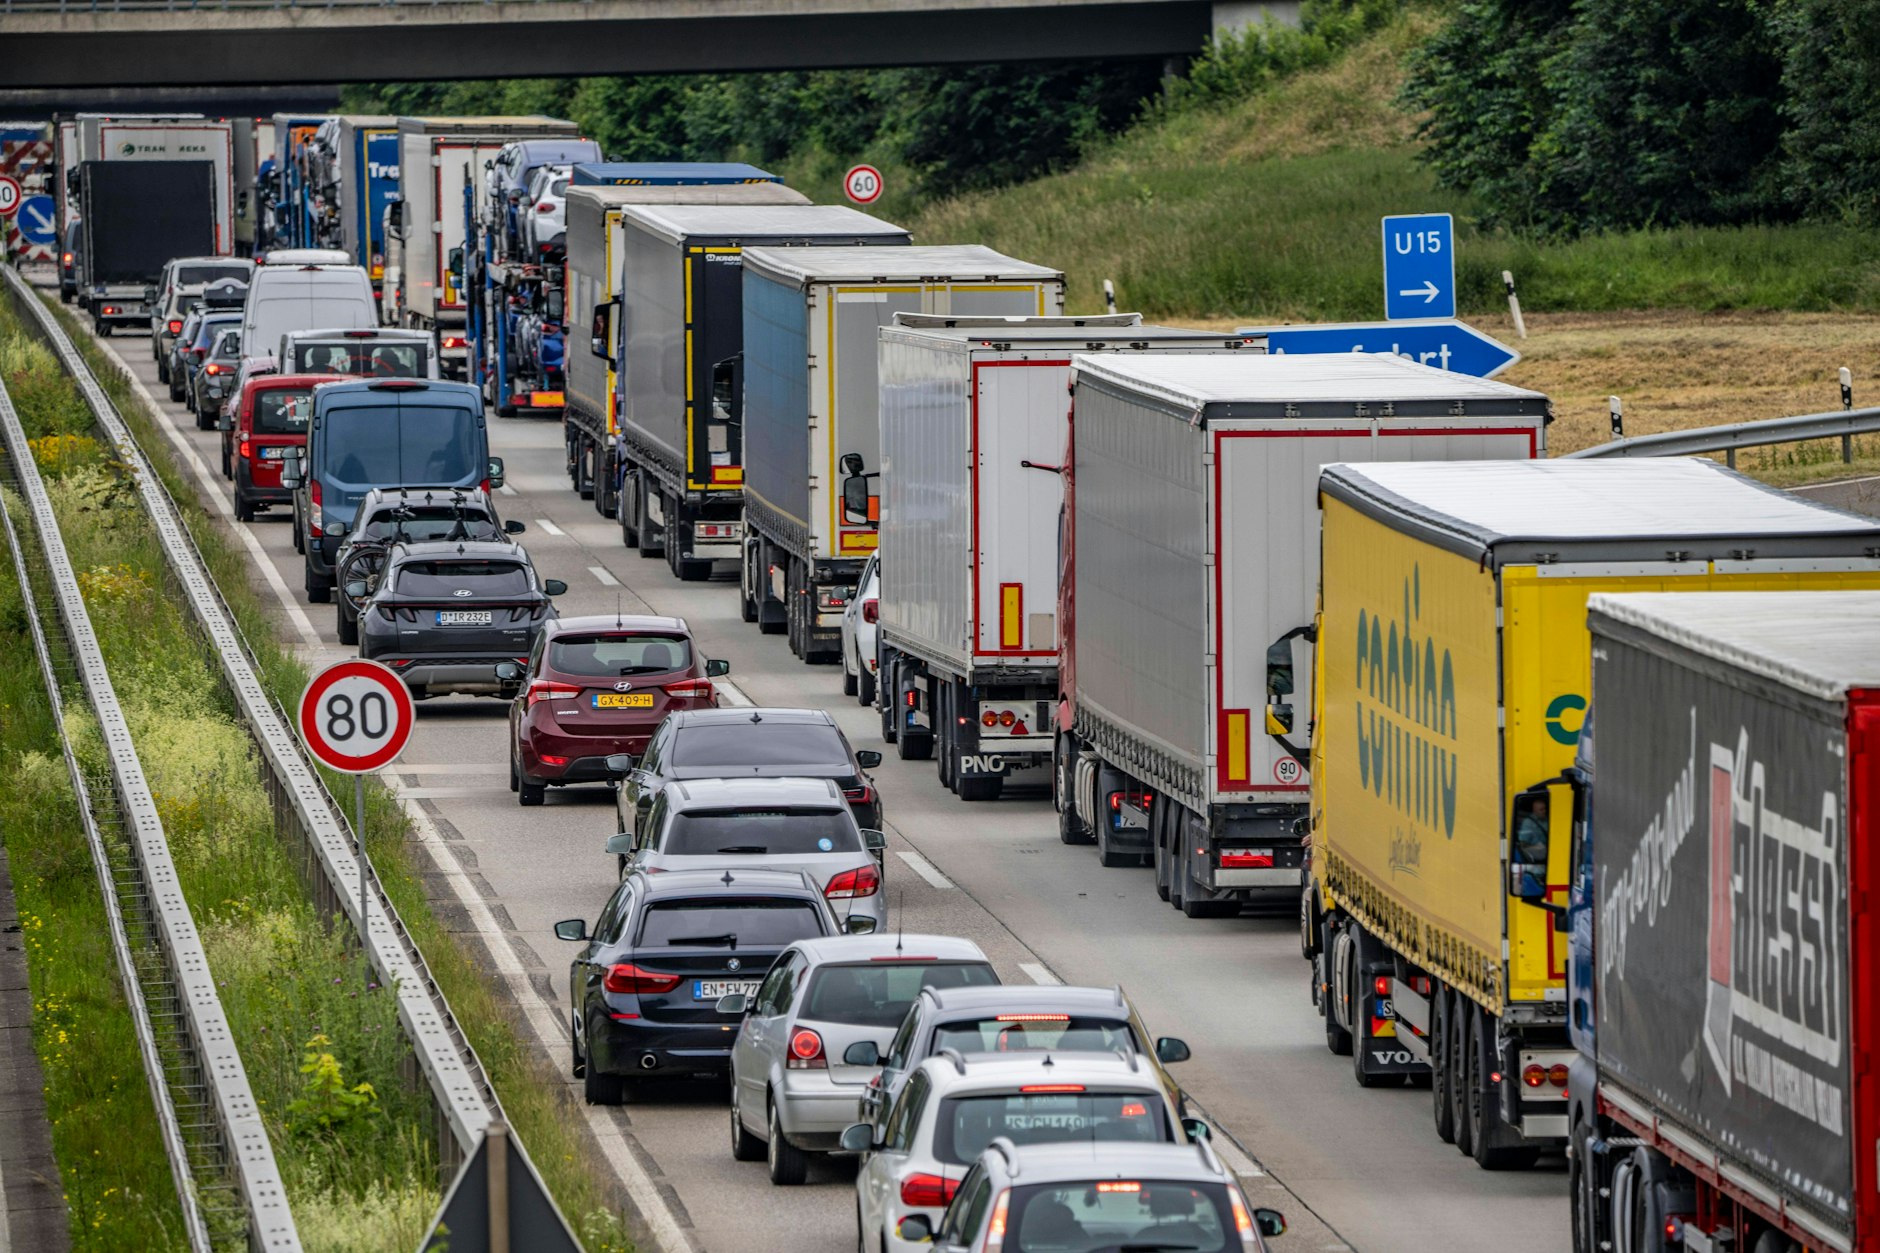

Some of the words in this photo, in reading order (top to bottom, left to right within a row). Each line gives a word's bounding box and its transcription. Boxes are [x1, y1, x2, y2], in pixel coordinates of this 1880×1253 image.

[854, 176, 875, 192] 60
[441, 613, 447, 622] D
[601, 696, 651, 705] GX-409-H
[327, 692, 388, 742] 80
[1280, 762, 1296, 775] 90
[702, 983, 718, 996] EN
